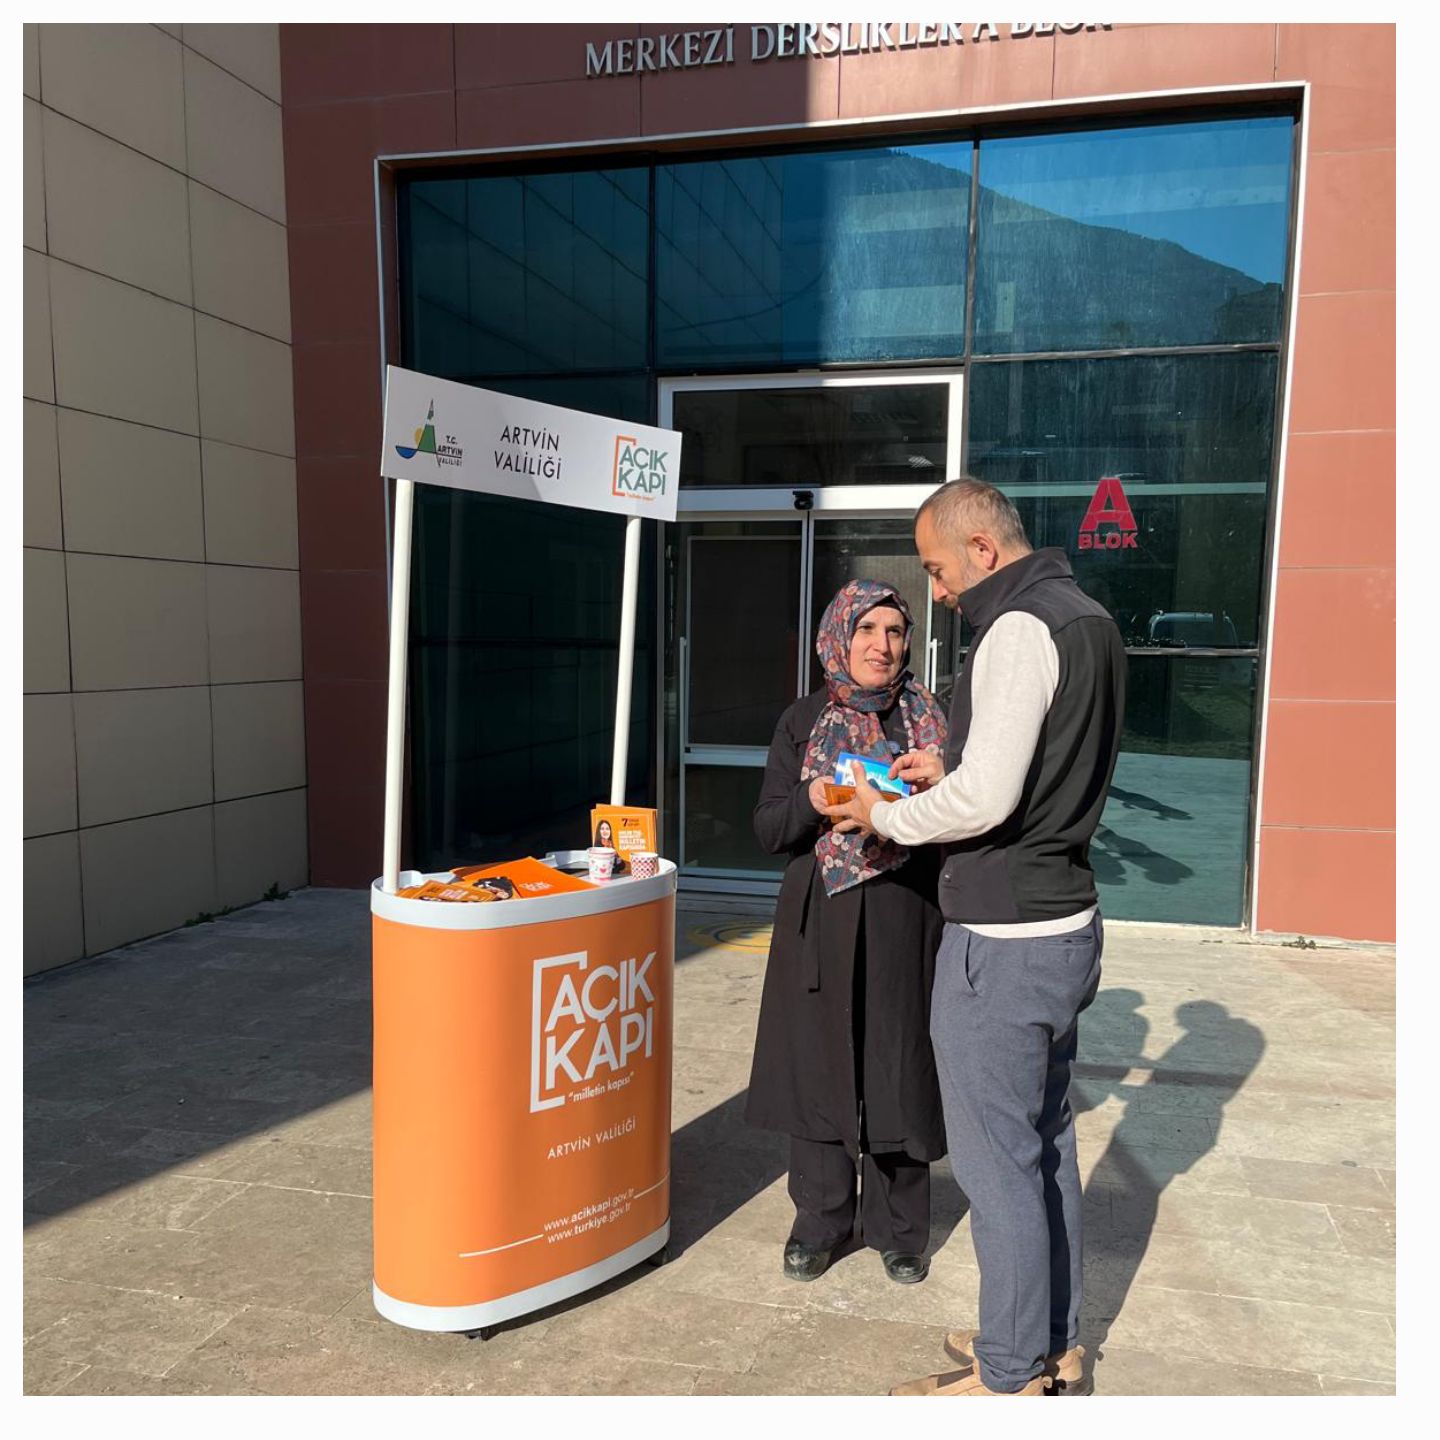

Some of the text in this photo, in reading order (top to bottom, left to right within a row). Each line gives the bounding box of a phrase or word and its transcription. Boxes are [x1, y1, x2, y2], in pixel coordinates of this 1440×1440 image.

[586, 23, 734, 76] MERKEZİ
[500, 425, 559, 452] ARTVİN
[619, 445, 668, 473] AÇIK
[494, 450, 562, 480] VALİLİĞİ
[618, 467, 666, 495] KAPI
[1079, 476, 1138, 532] A
[1077, 532, 1138, 550] BLOK
[544, 951, 658, 1032] AÇIK
[545, 1006, 653, 1091] KAPI
[548, 1115, 636, 1159] ARTVİN VALİLİĞİ
[544, 1188, 635, 1232] www.acikkapi.gov.tr
[546, 1202, 631, 1244] www.turkiye.gov.tr
